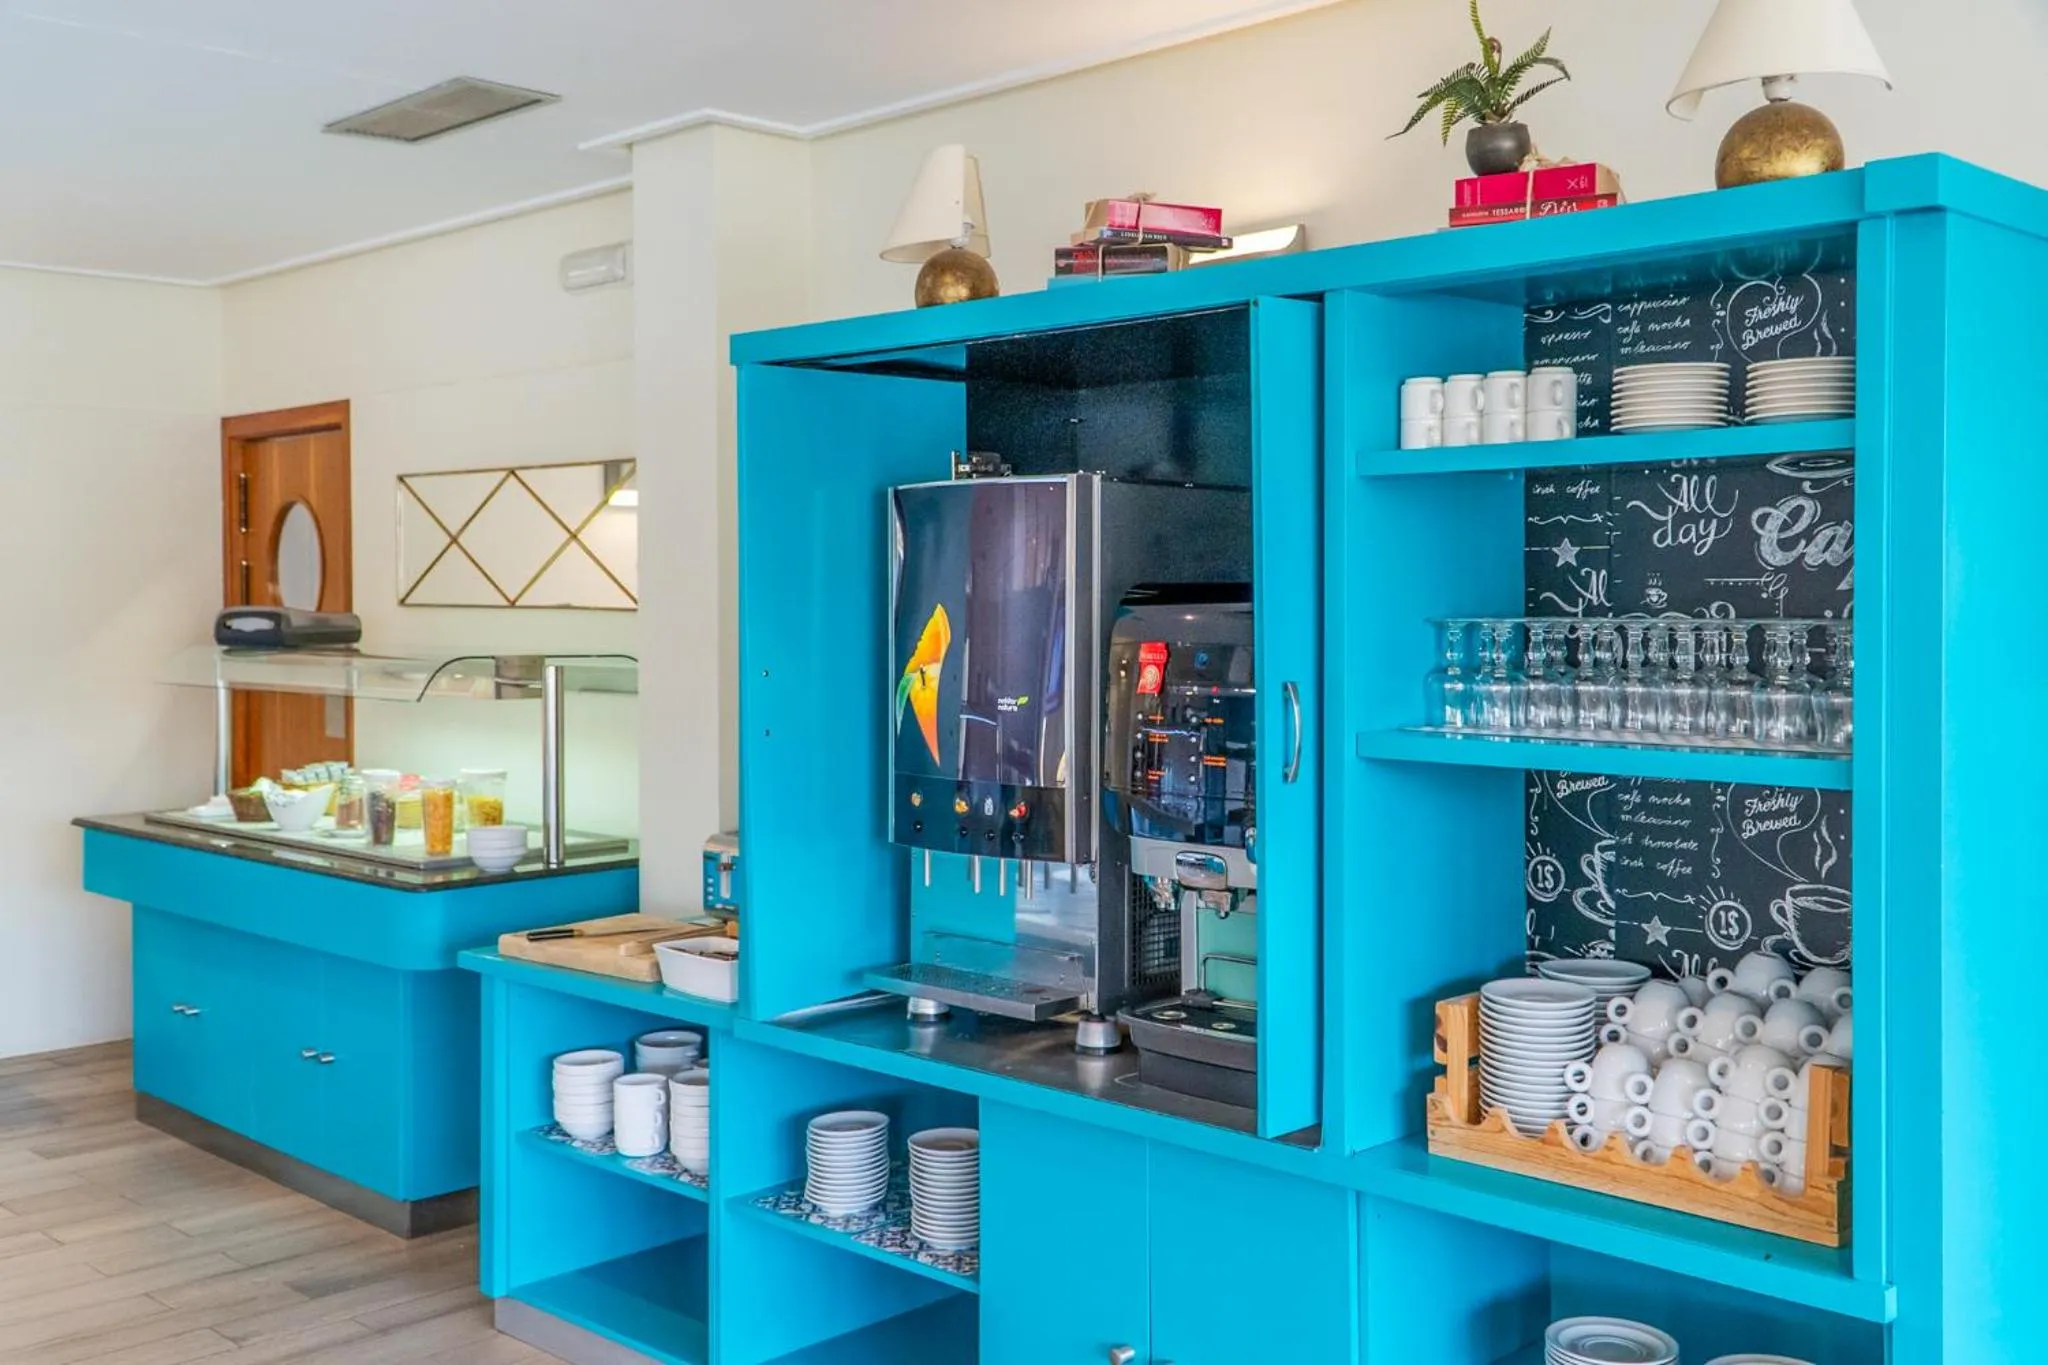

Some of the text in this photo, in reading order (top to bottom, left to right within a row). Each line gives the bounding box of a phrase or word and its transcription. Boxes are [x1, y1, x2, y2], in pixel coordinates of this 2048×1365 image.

[1647, 315, 1692, 332] mocha
[1743, 295, 1805, 328] Freshly
[1741, 312, 1803, 351] Brewed
[1565, 479, 1602, 501] coffee
[1626, 473, 1739, 521] All
[1652, 505, 1734, 557] day
[1751, 496, 1855, 567] Ca
[1556, 775, 1610, 799] Brewed
[1743, 790, 1805, 818] Freshly
[1741, 812, 1802, 840] Brewed
[1655, 857, 1693, 880] coffee
